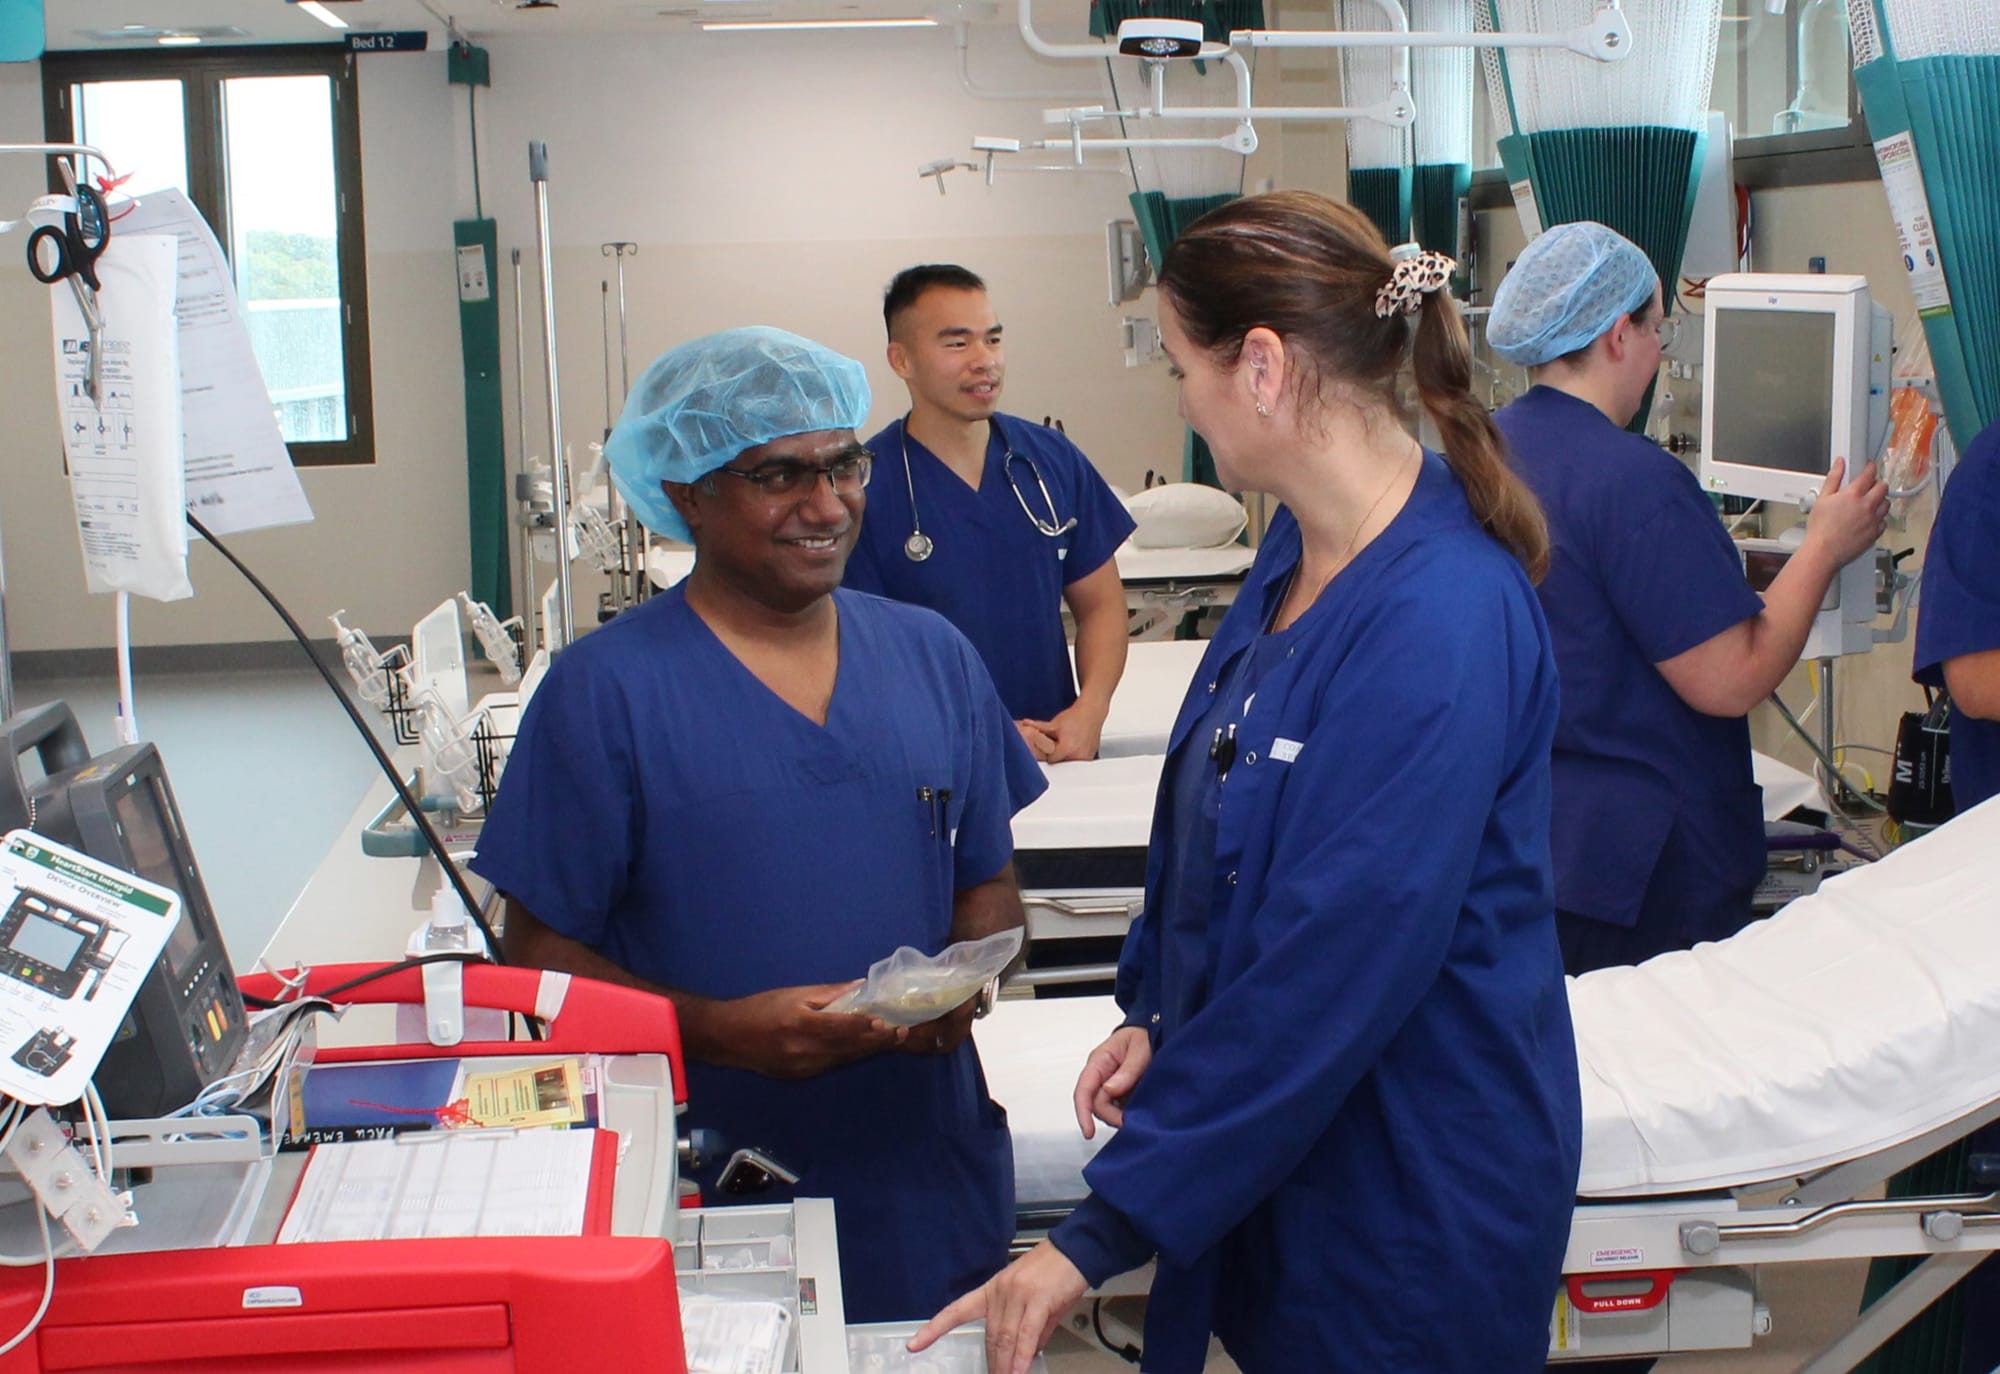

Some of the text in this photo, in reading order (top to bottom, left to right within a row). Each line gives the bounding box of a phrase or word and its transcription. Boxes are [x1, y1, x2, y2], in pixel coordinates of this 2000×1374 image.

[352, 35, 394, 48] Bed 12
[50, 854, 134, 895] HeartStart Intrepid
[1596, 1248, 1638, 1257] EMERGENCY
[1616, 1298, 1641, 1306] DOWN
